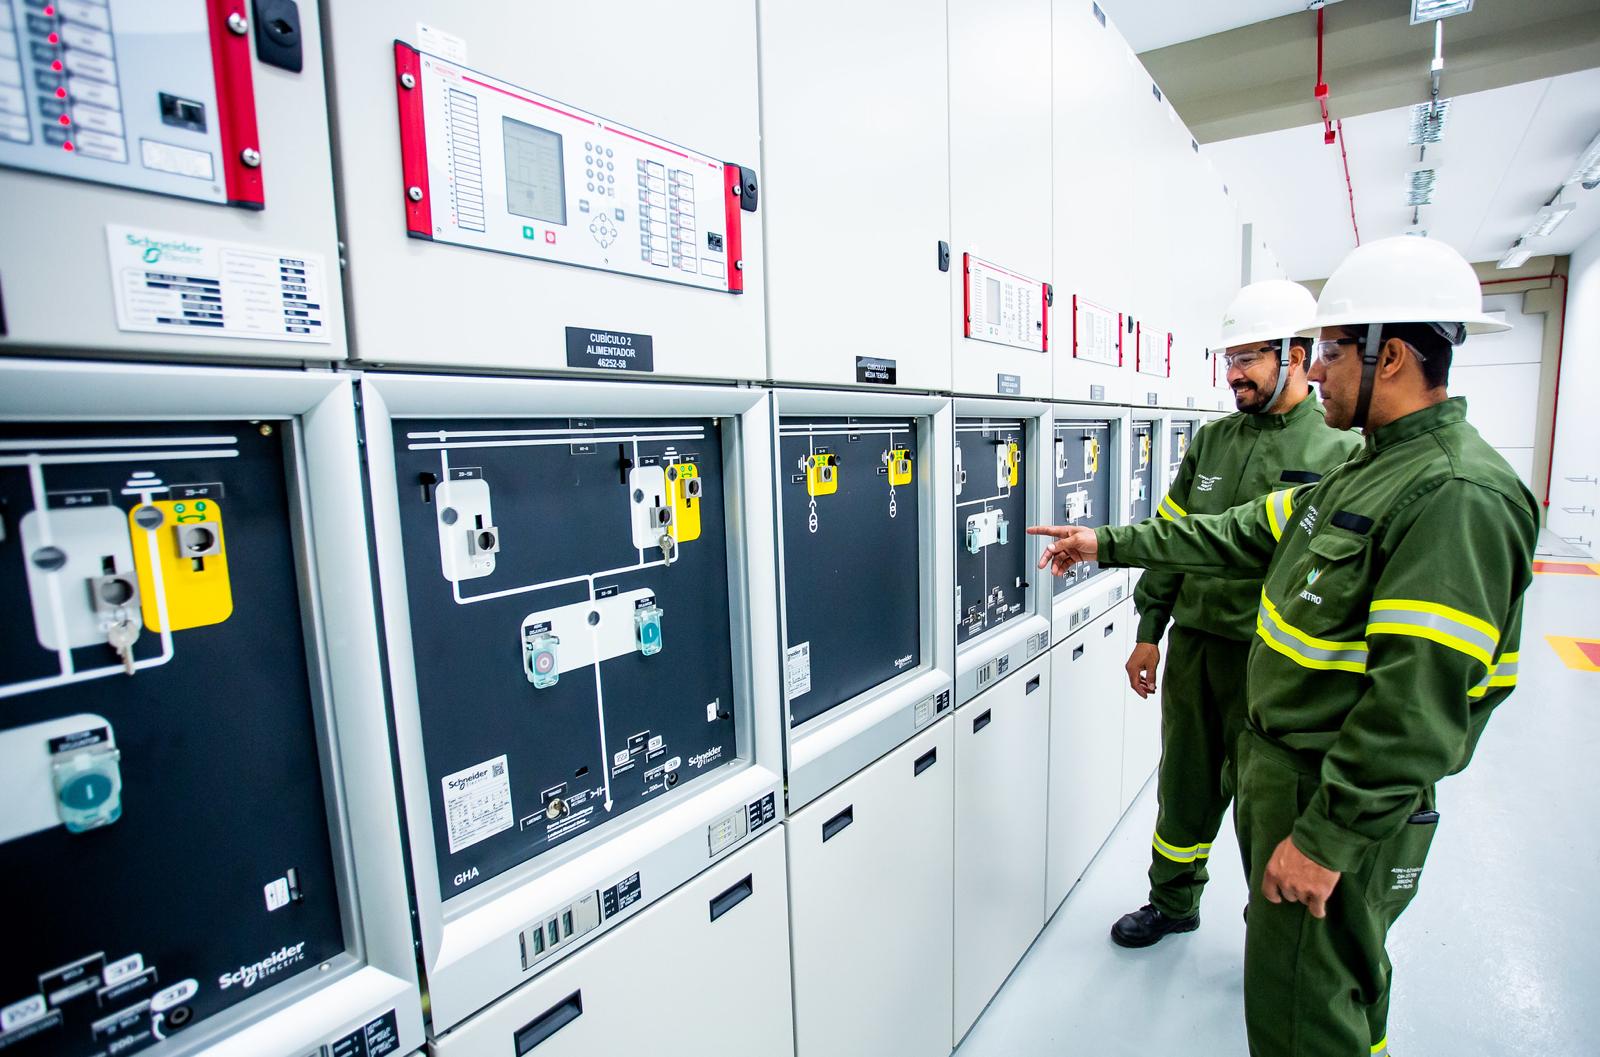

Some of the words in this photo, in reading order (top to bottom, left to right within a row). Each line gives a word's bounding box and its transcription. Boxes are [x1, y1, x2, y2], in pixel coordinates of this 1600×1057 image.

[590, 332, 626, 346] CUBÍCULO
[627, 337, 632, 346] 2
[586, 345, 636, 357] ALIMENTADOR
[688, 746, 722, 767] Schneider
[448, 769, 488, 789] Schneider
[453, 866, 480, 886] GHA
[218, 941, 305, 990] Schneider
[259, 952, 305, 980] Electric
